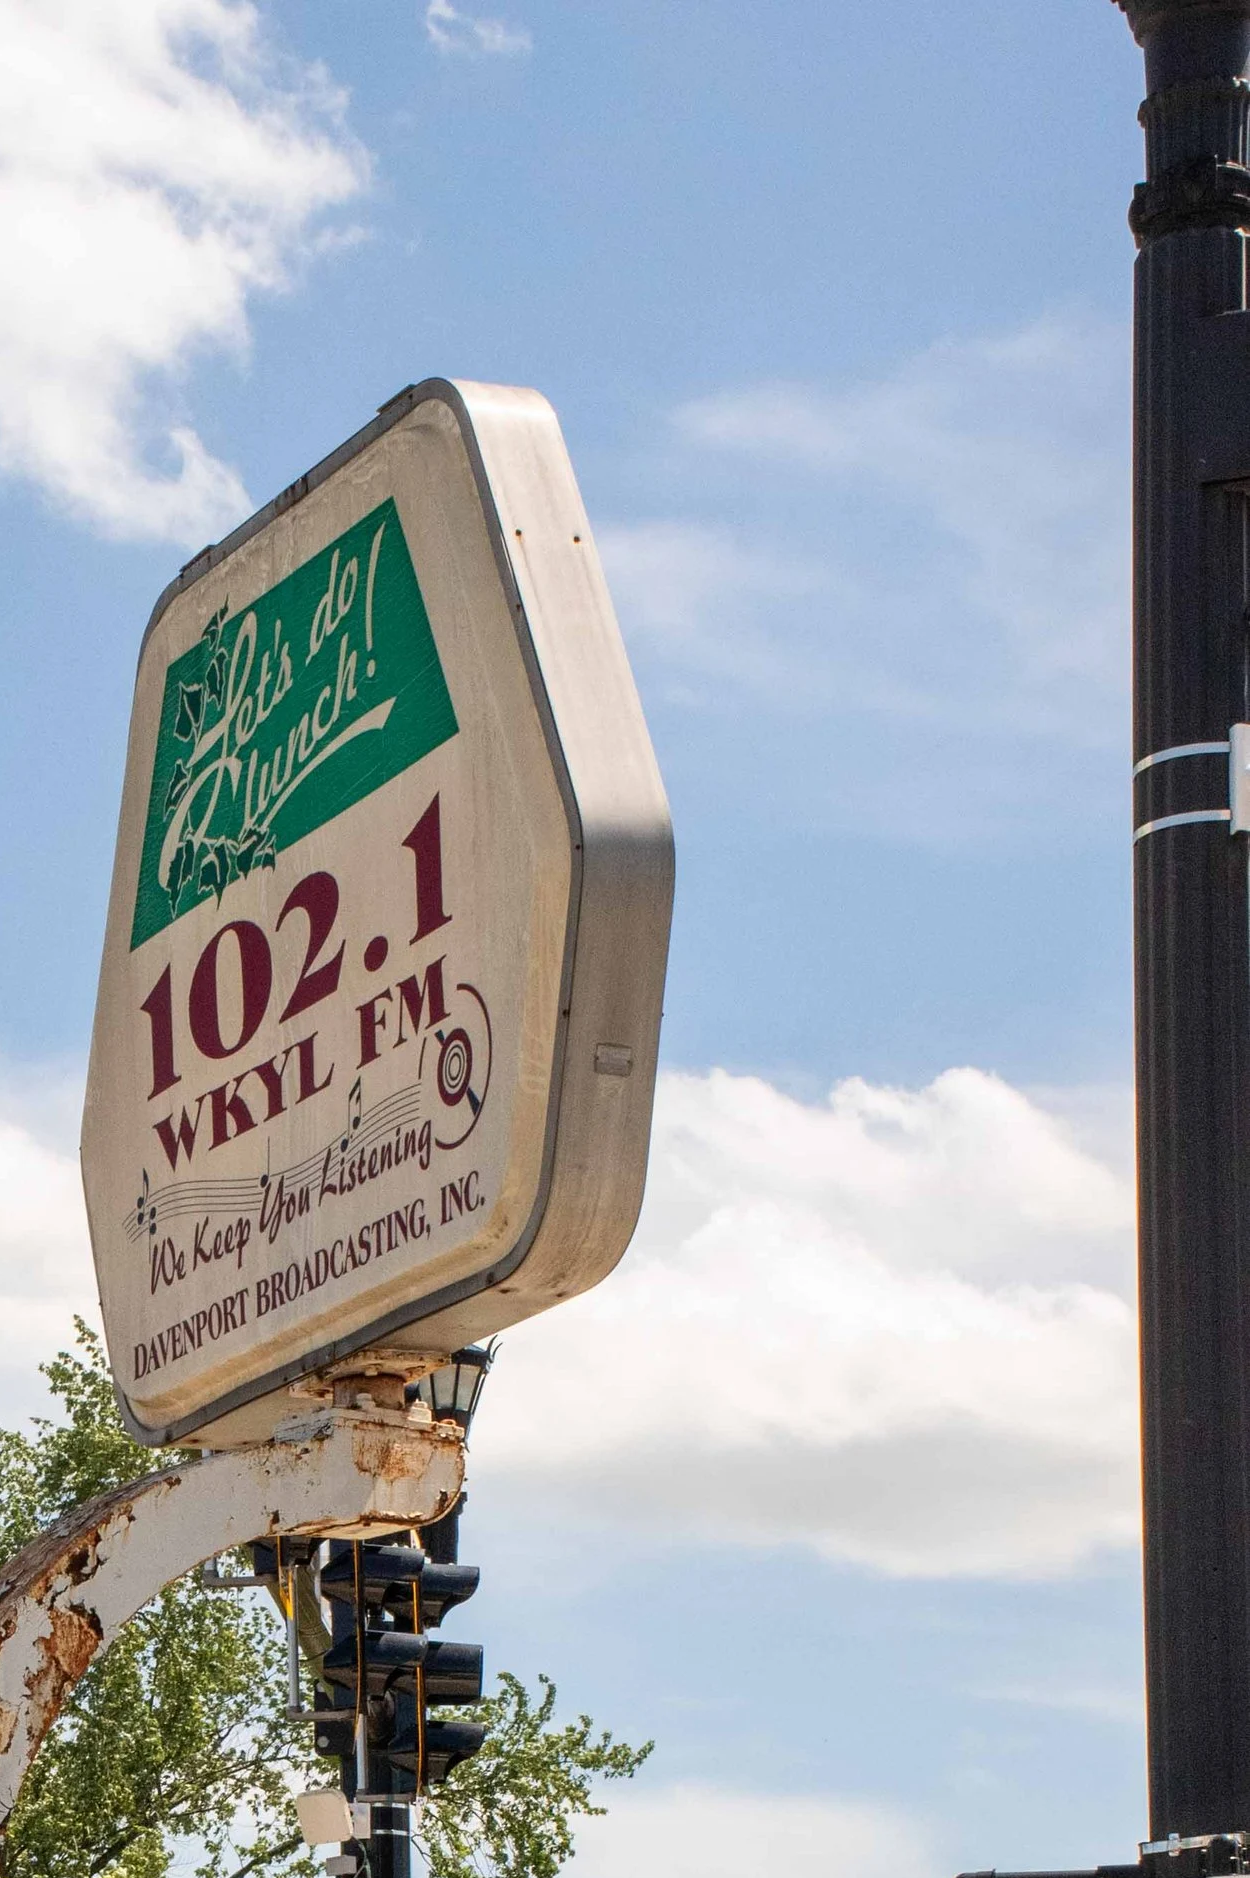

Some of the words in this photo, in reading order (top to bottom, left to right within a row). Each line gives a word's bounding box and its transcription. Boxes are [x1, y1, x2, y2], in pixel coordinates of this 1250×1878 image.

[187, 611, 293, 767] Let's
[140, 790, 453, 1101] 102.1
[152, 1031, 335, 1173] WKYL
[355, 954, 451, 1070] FM
[133, 1288, 250, 1381] DAVENPORT
[255, 1198, 431, 1318] BROADCASTING,
[440, 1170, 486, 1227] INC.
[151, 1238, 186, 1295] We
[192, 1214, 252, 1271] Keep
[259, 1175, 310, 1245] You
[318, 1119, 432, 1207] Listening
